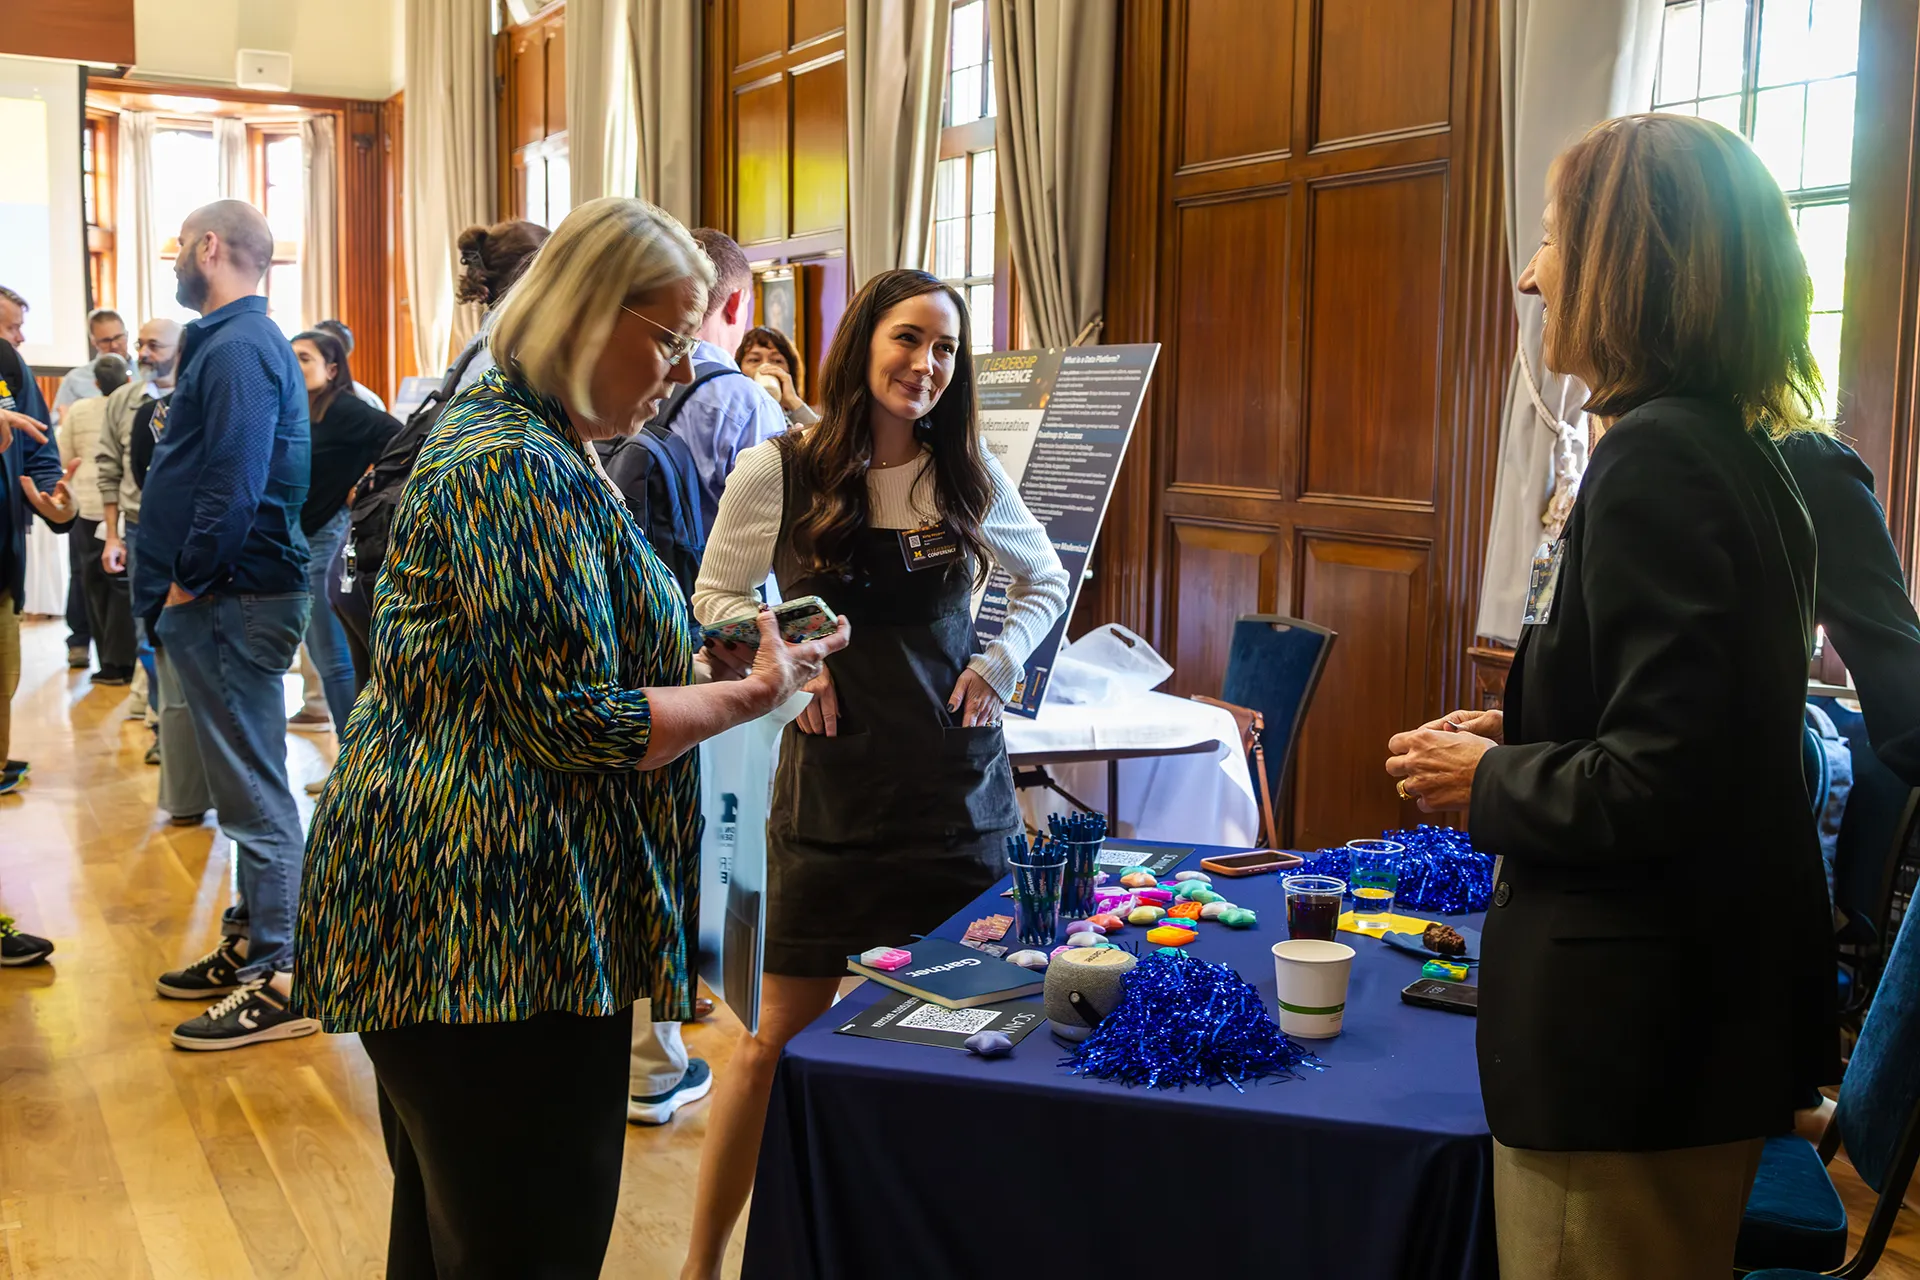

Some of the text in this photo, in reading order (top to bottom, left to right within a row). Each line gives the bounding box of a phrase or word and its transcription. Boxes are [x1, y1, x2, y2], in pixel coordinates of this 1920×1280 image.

[982, 355, 1038, 371] IT LEADERSHIP
[976, 369, 1033, 385] CONFERENCE
[927, 547, 956, 559] CONFERENCE
